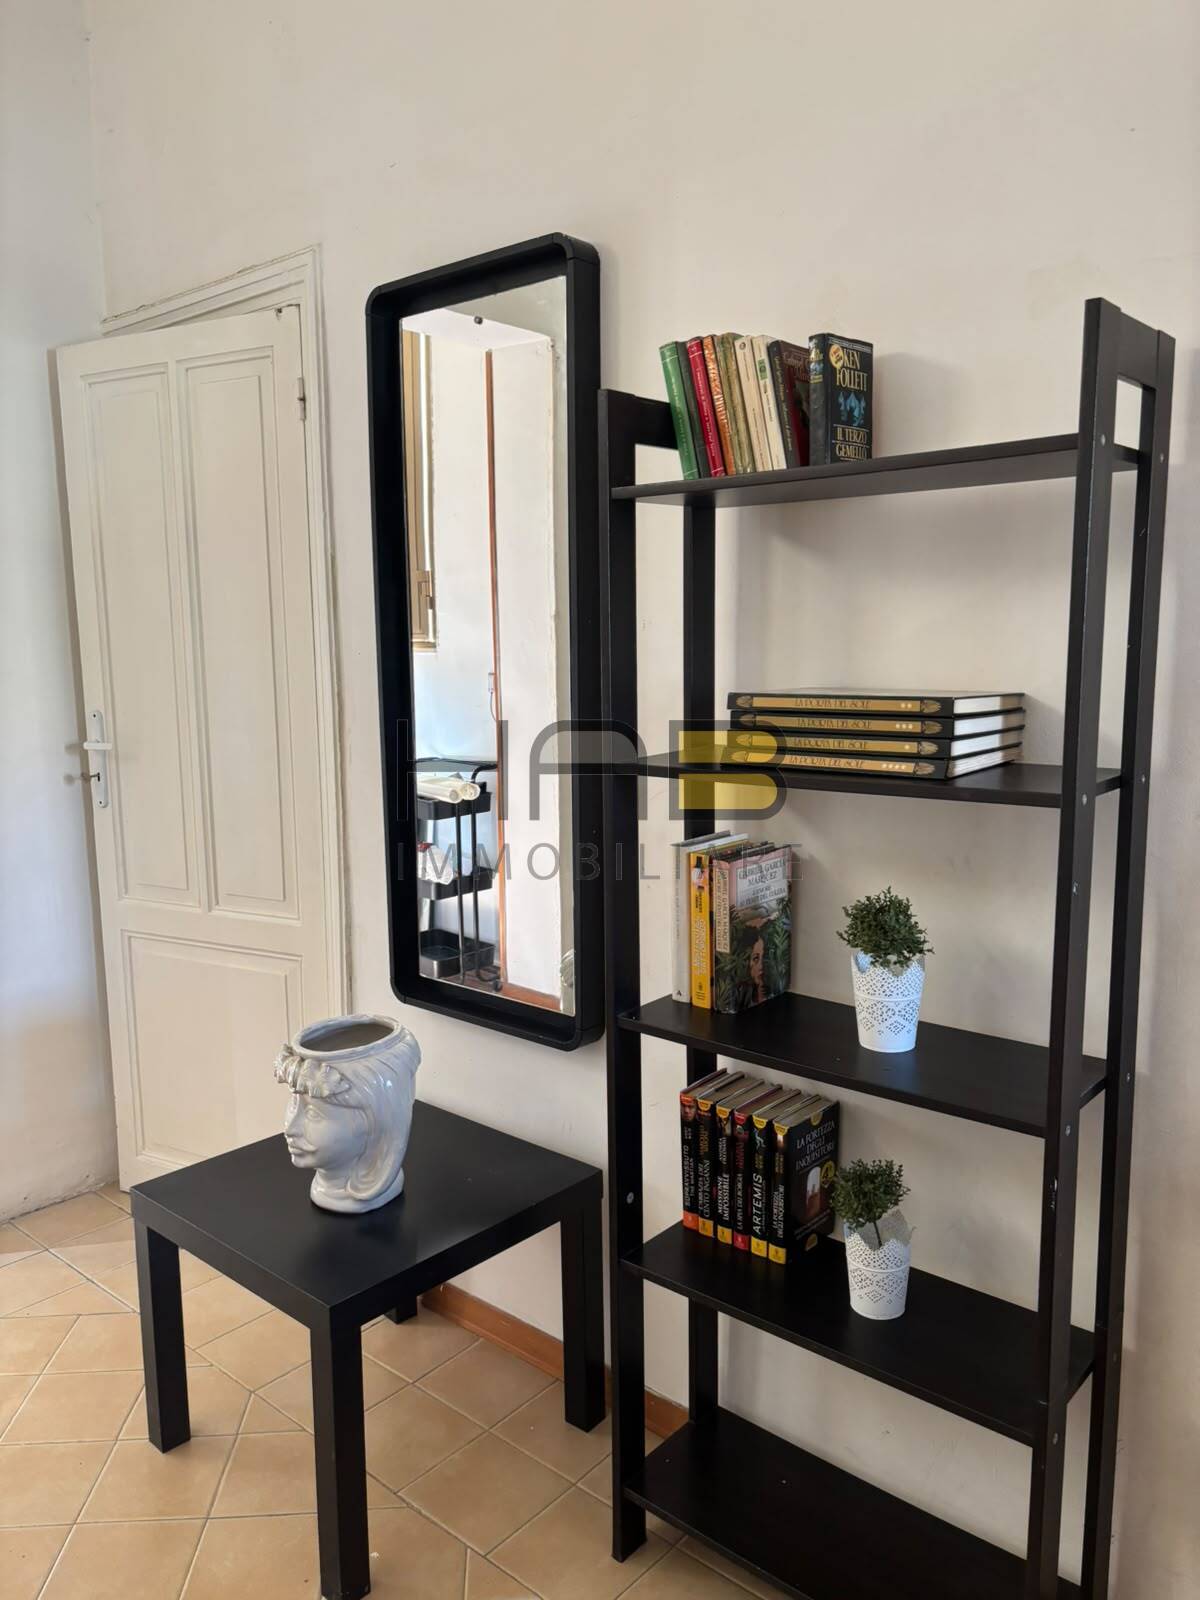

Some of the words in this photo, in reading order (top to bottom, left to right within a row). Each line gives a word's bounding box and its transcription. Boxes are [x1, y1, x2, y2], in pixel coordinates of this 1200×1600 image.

[843, 348, 860, 370] KEN
[836, 366, 868, 391] FOLLETT
[837, 427, 844, 441] IL
[845, 428, 867, 444] TERZO
[836, 444, 867, 460] GEMELLO
[805, 700, 833, 708] PORTA
[849, 701, 872, 709] SOLE
[807, 719, 834, 728] PORTA
[849, 720, 872, 729] SOLE
[804, 739, 832, 748] PORTA
[848, 740, 867, 749] SOLE
[799, 757, 828, 766] PORTA
[844, 760, 864, 769] SOLE
[806, 1120, 835, 1142] FORTEZZA
[796, 1142, 834, 1170] INQUISITORI
[683, 1145, 691, 1207] SOPRAVVISSUTO
[722, 1173, 730, 1220] IMPOSSIBILE
[753, 1173, 762, 1234] ARTEMIS
[777, 1185, 785, 1221] INQUISITORI
[737, 1221, 743, 1230] LA
